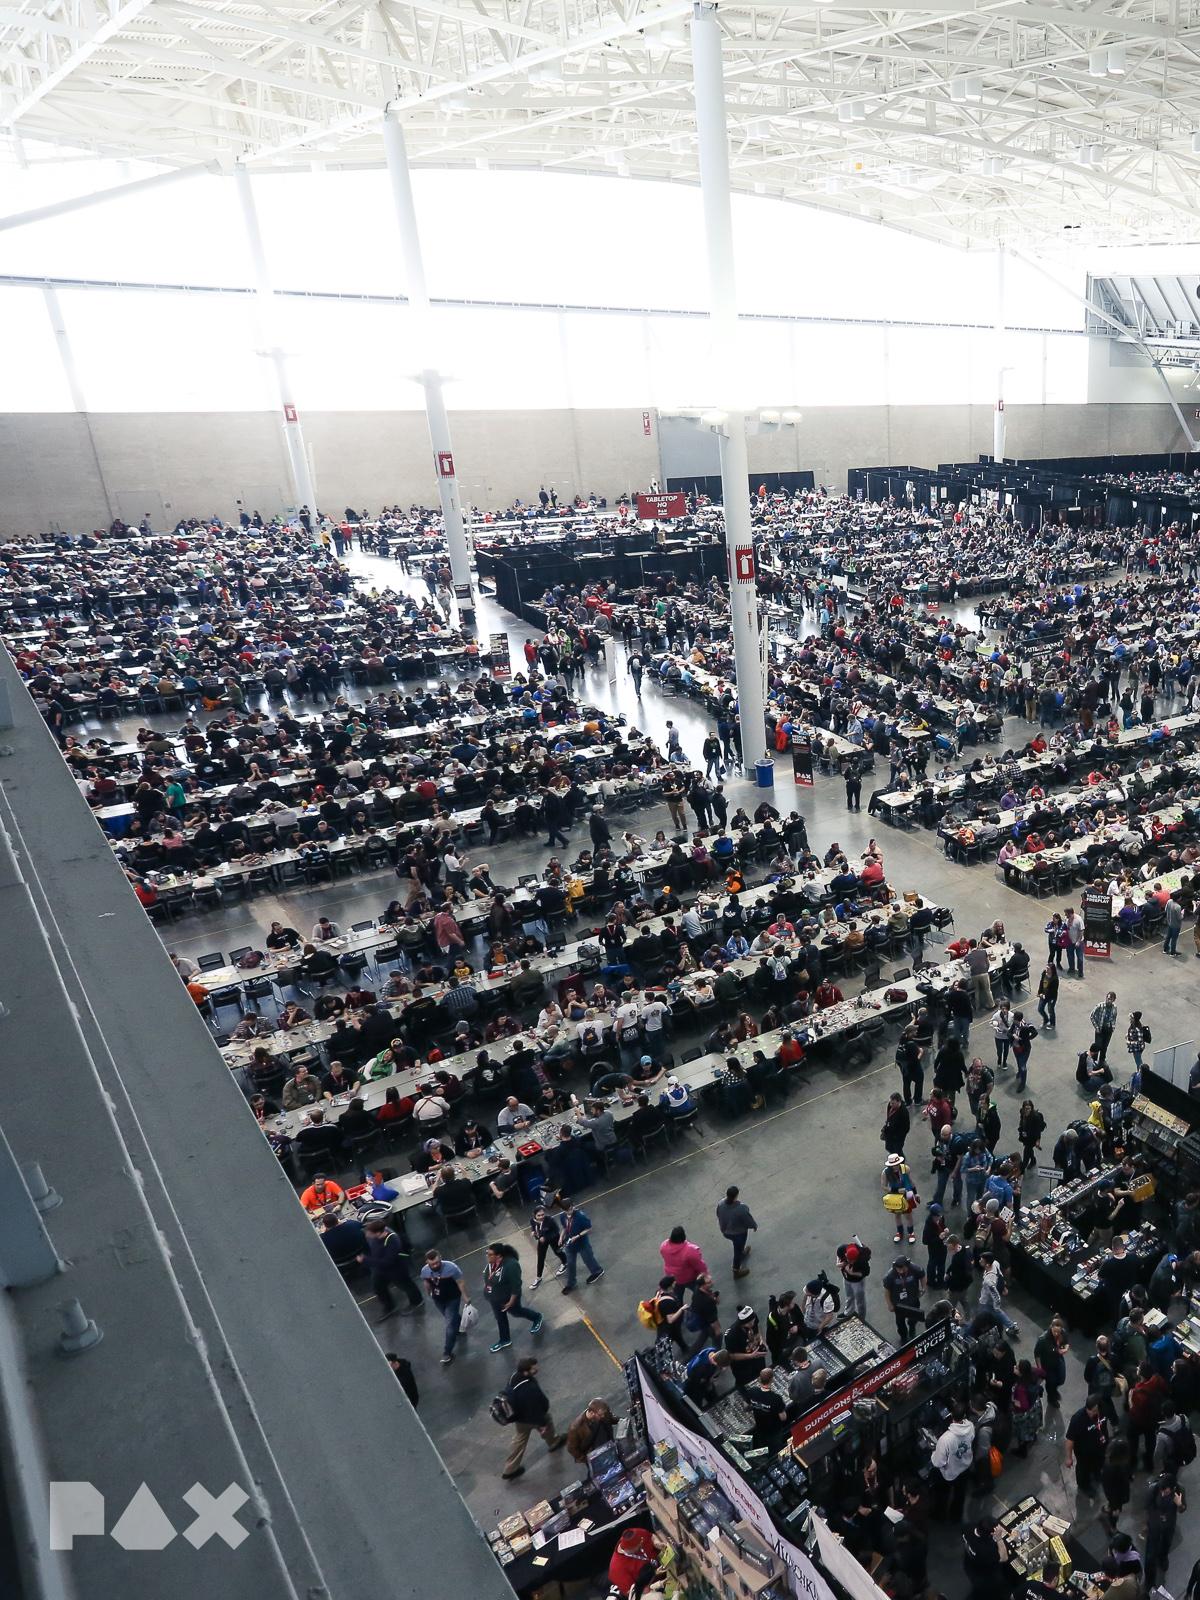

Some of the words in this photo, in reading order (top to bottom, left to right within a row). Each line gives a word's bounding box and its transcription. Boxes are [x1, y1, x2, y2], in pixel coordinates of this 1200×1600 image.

[645, 495, 677, 503] TABLETOP
[1086, 940, 1107, 949] PAX
[804, 1396, 851, 1432] DUNGEONS
[851, 1386, 864, 1400] &
[863, 1361, 901, 1390] DRAGONS
